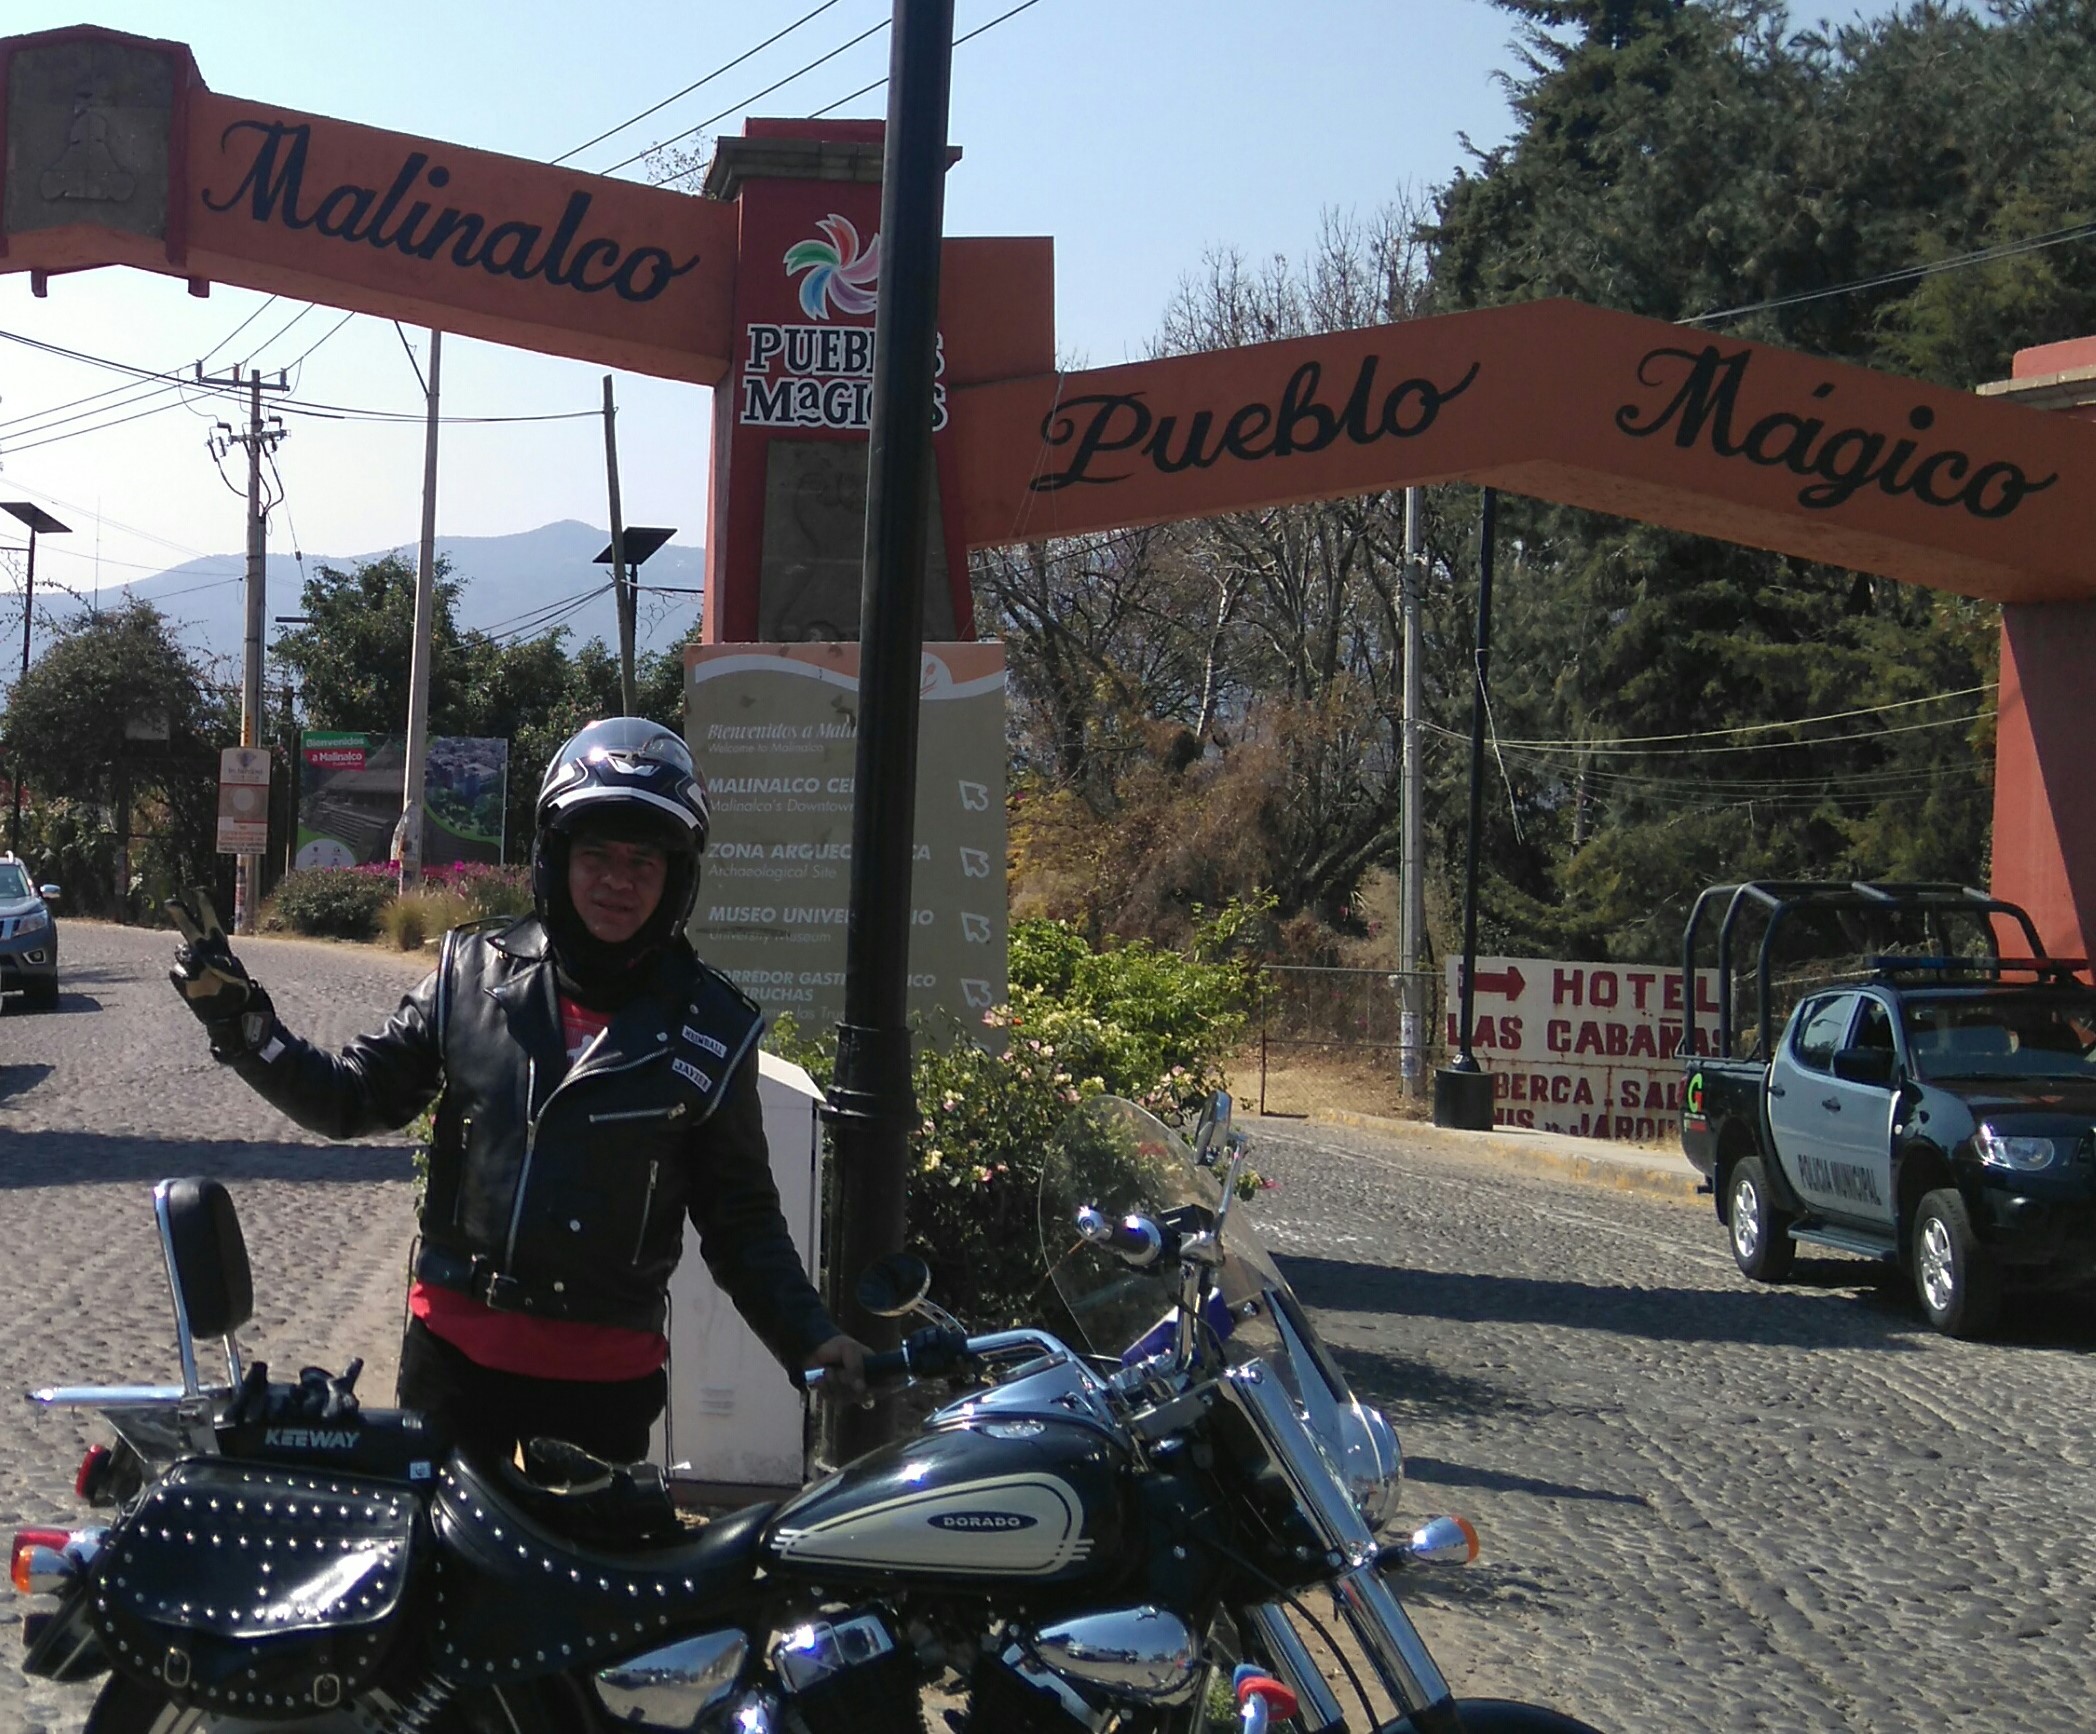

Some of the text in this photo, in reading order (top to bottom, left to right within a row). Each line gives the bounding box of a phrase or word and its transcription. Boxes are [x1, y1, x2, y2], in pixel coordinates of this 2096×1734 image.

[201, 120, 699, 301] Malinalco
[745, 325, 945, 377] PUEB
[1030, 345, 2059, 519] Pueblo Mágico
[802, 725, 812, 738] a
[306, 737, 364, 747] Bienvenidos
[708, 742, 824, 753] Welcome to Malinalco
[319, 751, 362, 761] Malinalco
[708, 778, 820, 793] MALINALCO
[710, 798, 782, 812] Malinalco's
[708, 843, 763, 859] ZONA
[708, 864, 837, 881] Archaeological Site
[708, 907, 776, 923] MUSEO
[742, 986, 813, 1001] TRUCHAS
[1553, 968, 1720, 1013] HOTEL
[1447, 1013, 1523, 1050] LAS
[265, 1428, 360, 1448] KEEWAY
[944, 1516, 1020, 1527] DORADO
